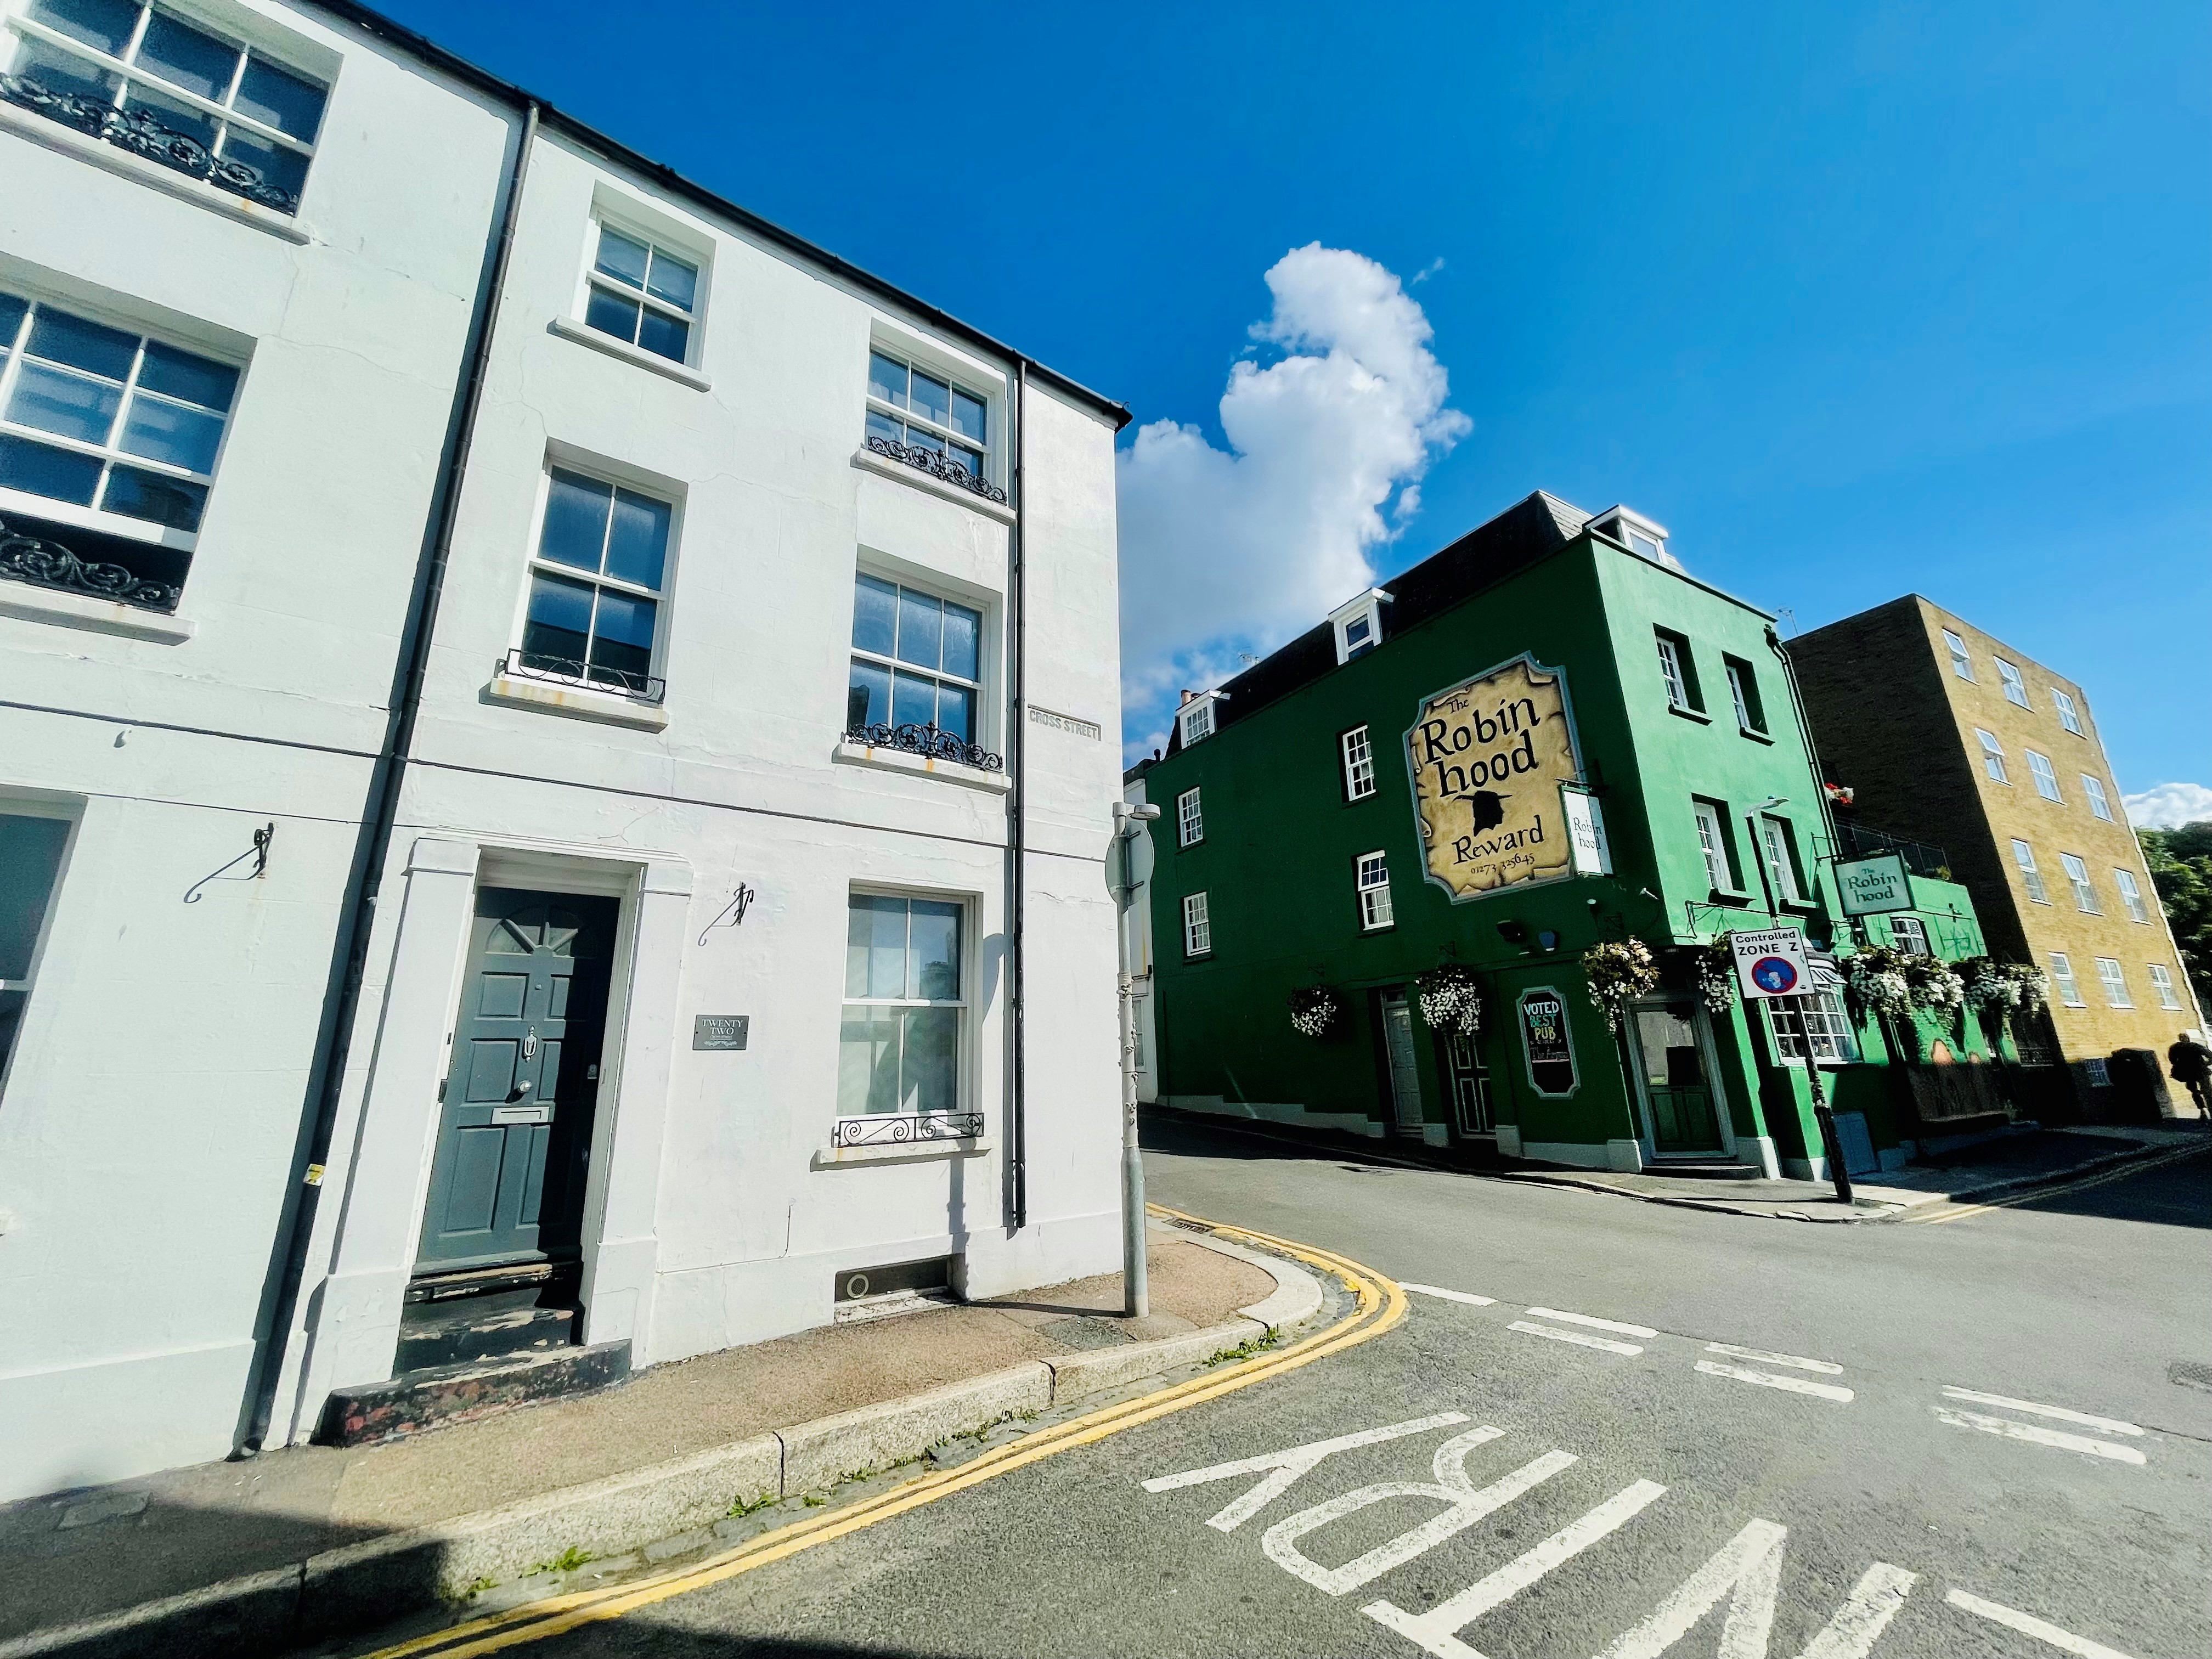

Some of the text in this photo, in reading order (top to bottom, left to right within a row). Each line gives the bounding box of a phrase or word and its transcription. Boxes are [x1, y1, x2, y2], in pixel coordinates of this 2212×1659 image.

[1447, 698, 1469, 713] The
[1029, 710, 1097, 739] CROSS STREET
[1419, 697, 1541, 764] Robin
[1433, 729, 1539, 798] hood
[1451, 815, 1545, 865] Reward
[1470, 853, 1535, 876] 01273 325645
[1847, 872, 1898, 889] Robin
[1853, 885, 1895, 903] hood
[1735, 931, 1796, 943] Controlled
[1737, 942, 1798, 956] ZONE Z
[1523, 1001, 1559, 1016] VOTED
[702, 1019, 743, 1028] TWENTY
[1530, 1014, 1556, 1028] BEST
[710, 1027, 735, 1035] TWO
[1534, 1026, 1556, 1040] PUB
[1140, 1411, 2135, 1659] NTRY
